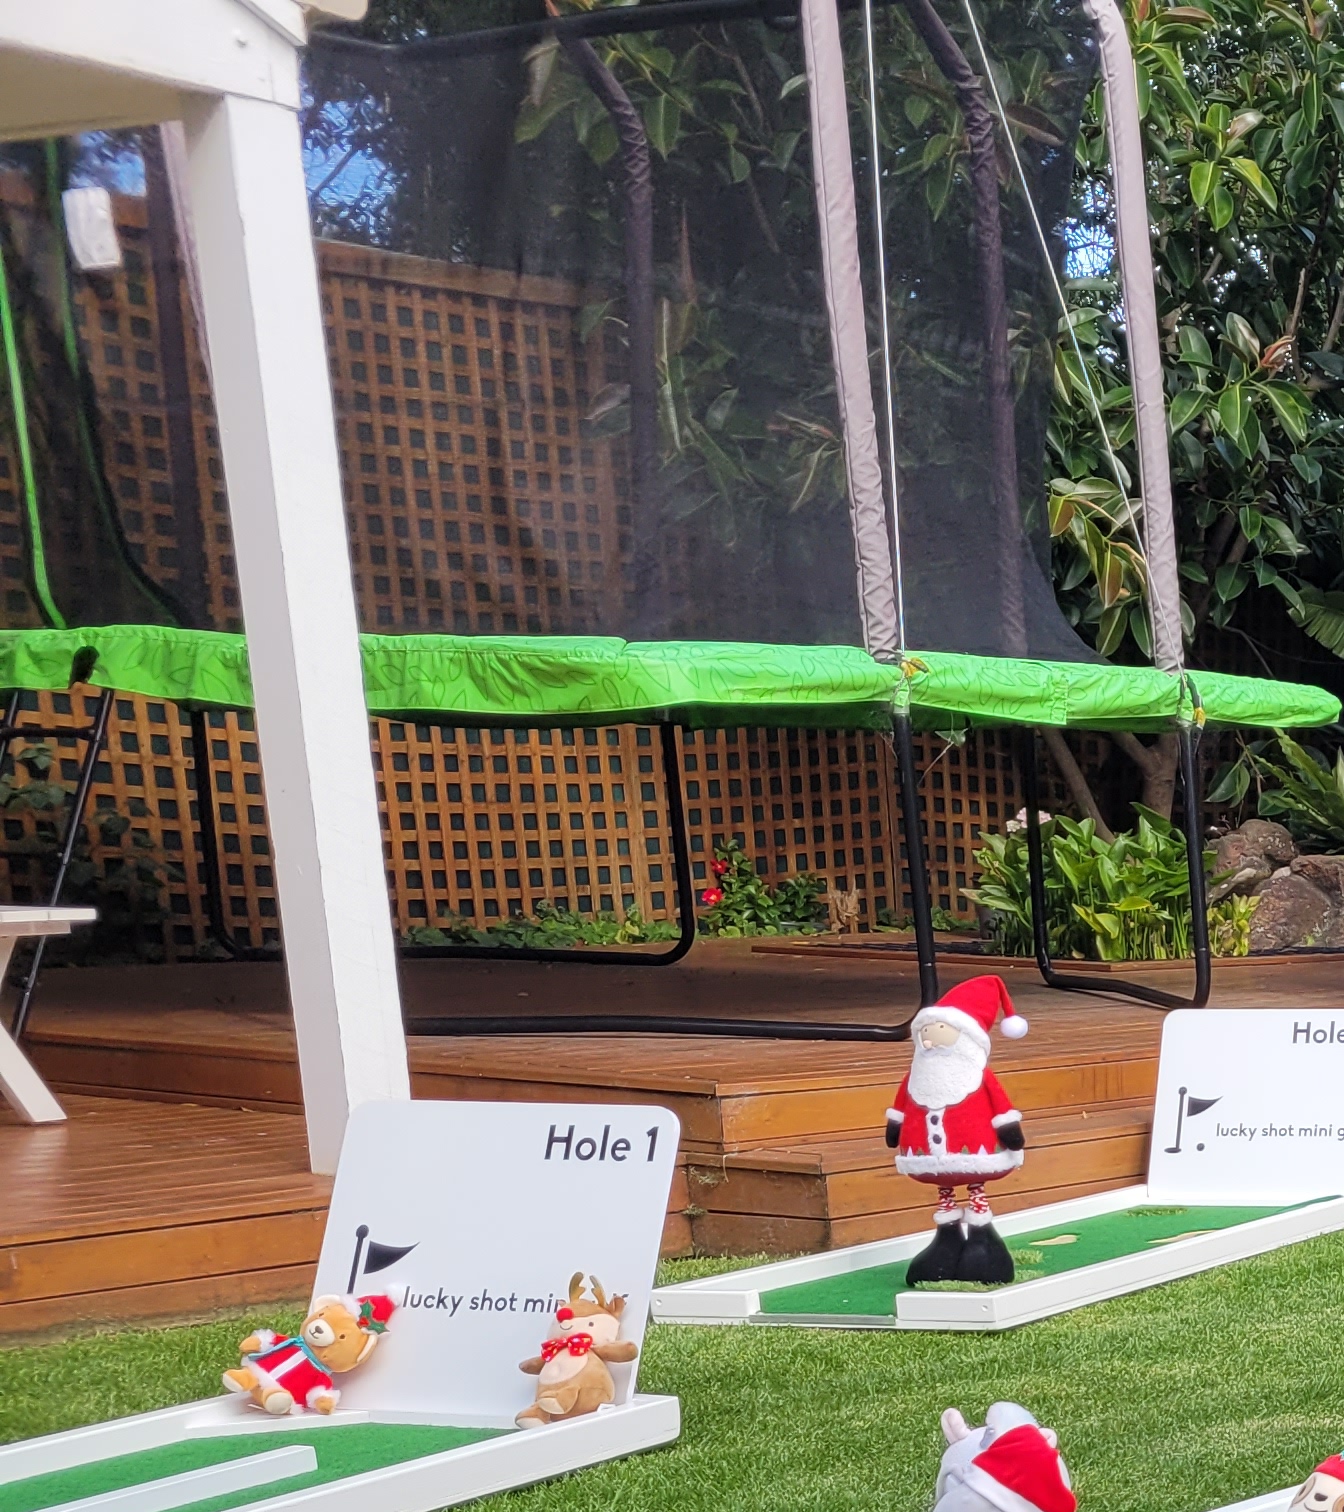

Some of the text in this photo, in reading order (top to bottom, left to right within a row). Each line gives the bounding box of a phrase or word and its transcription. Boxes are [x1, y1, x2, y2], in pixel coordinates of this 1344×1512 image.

[545, 1125, 658, 1161] Hole 1
[1217, 1123, 1257, 1141] lucky
[1262, 1123, 1294, 1136] shot
[1299, 1124, 1332, 1136] mini
[403, 1286, 566, 1317] lucky shot min
